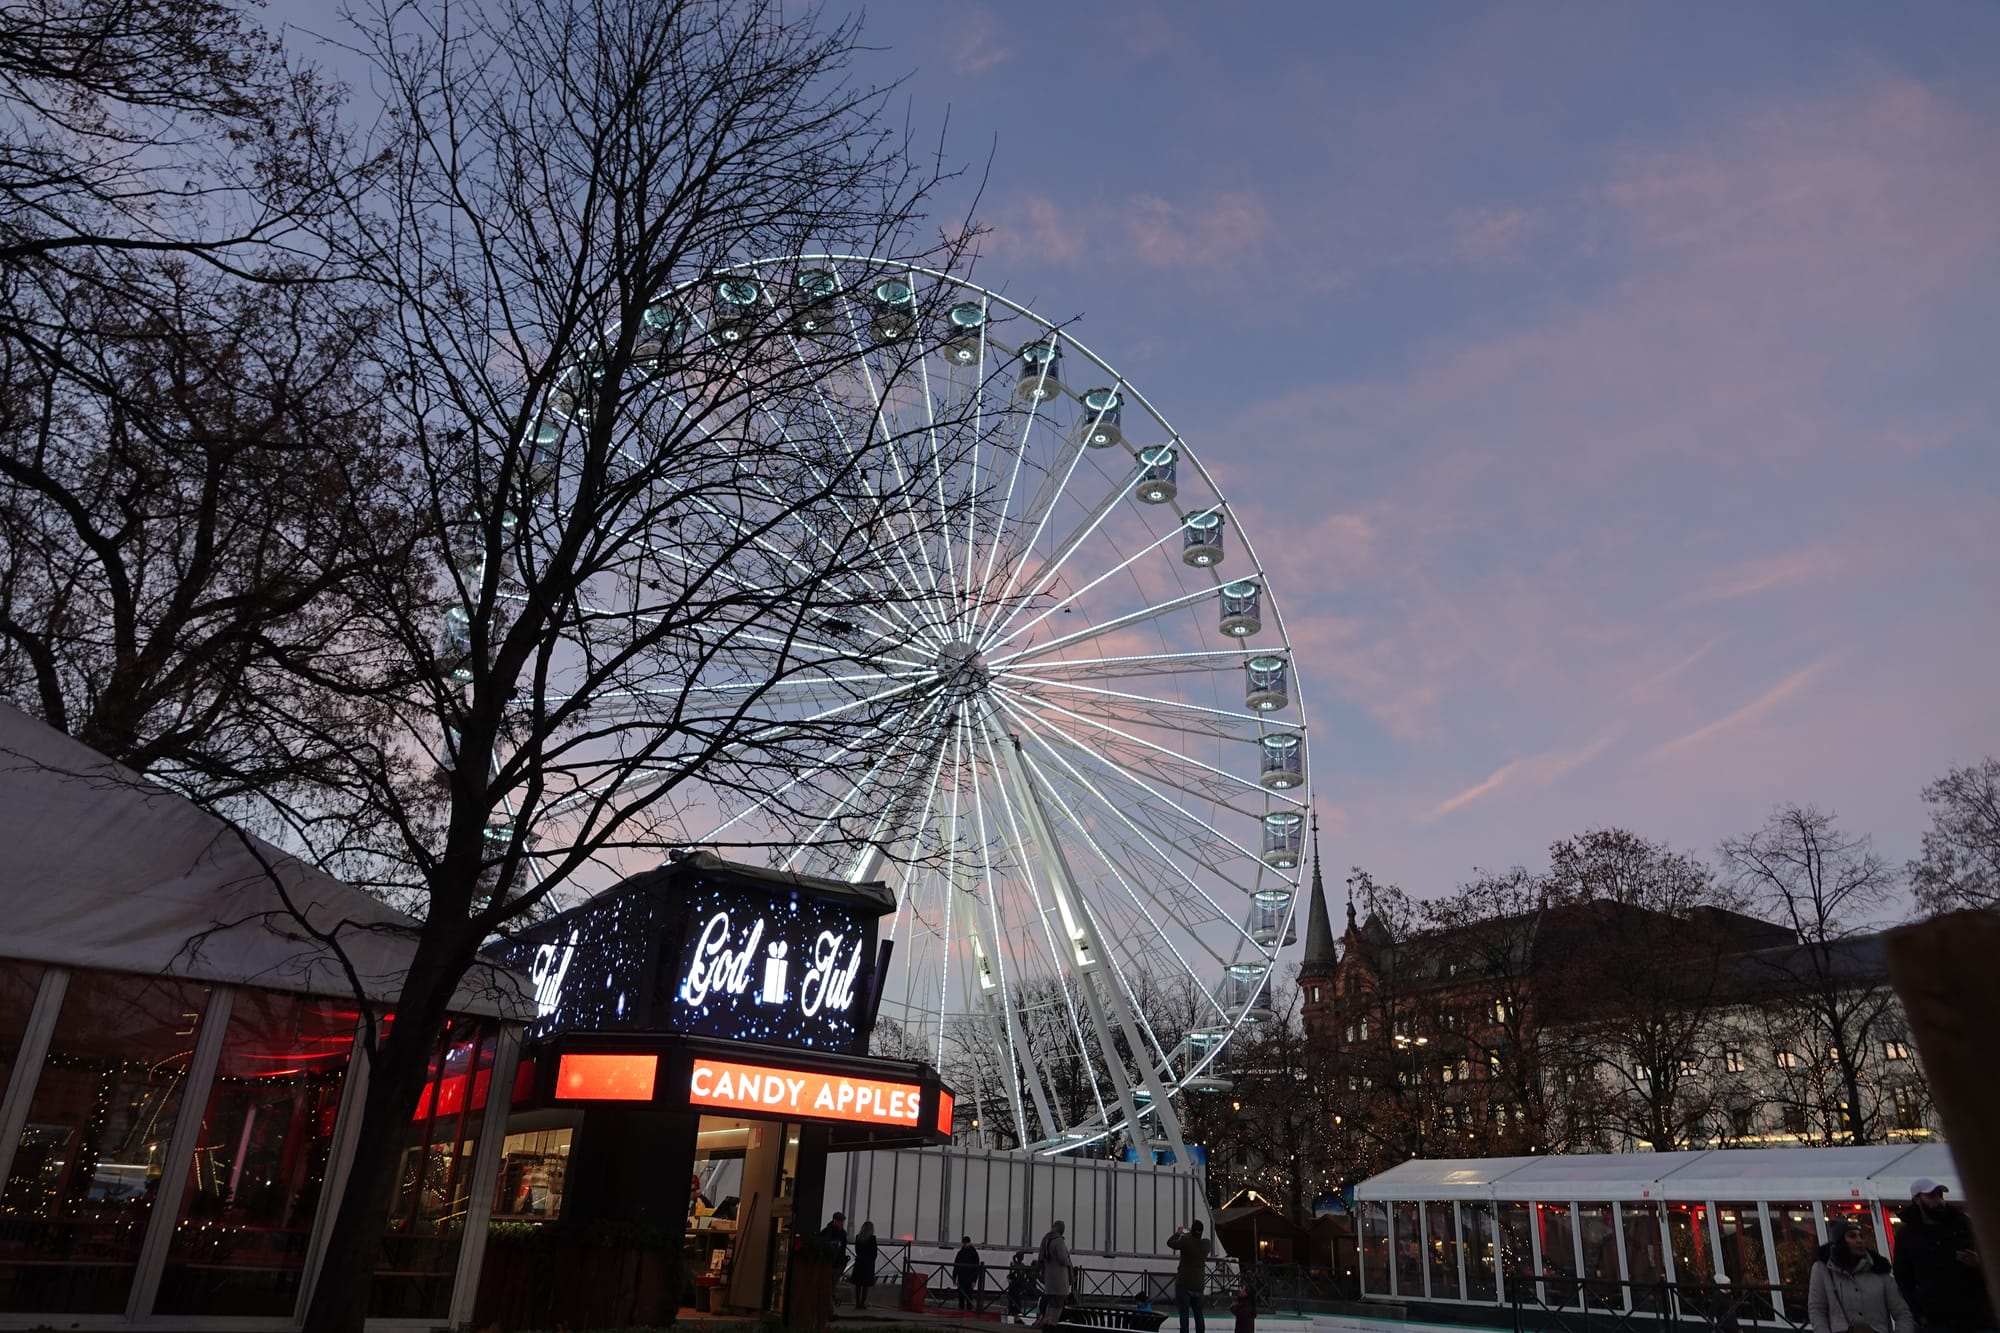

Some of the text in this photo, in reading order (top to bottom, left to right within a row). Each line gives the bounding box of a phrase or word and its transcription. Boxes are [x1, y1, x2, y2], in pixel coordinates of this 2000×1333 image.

[686, 911, 863, 1017] God Jul
[690, 1067, 921, 1120] CANDY APPLES
